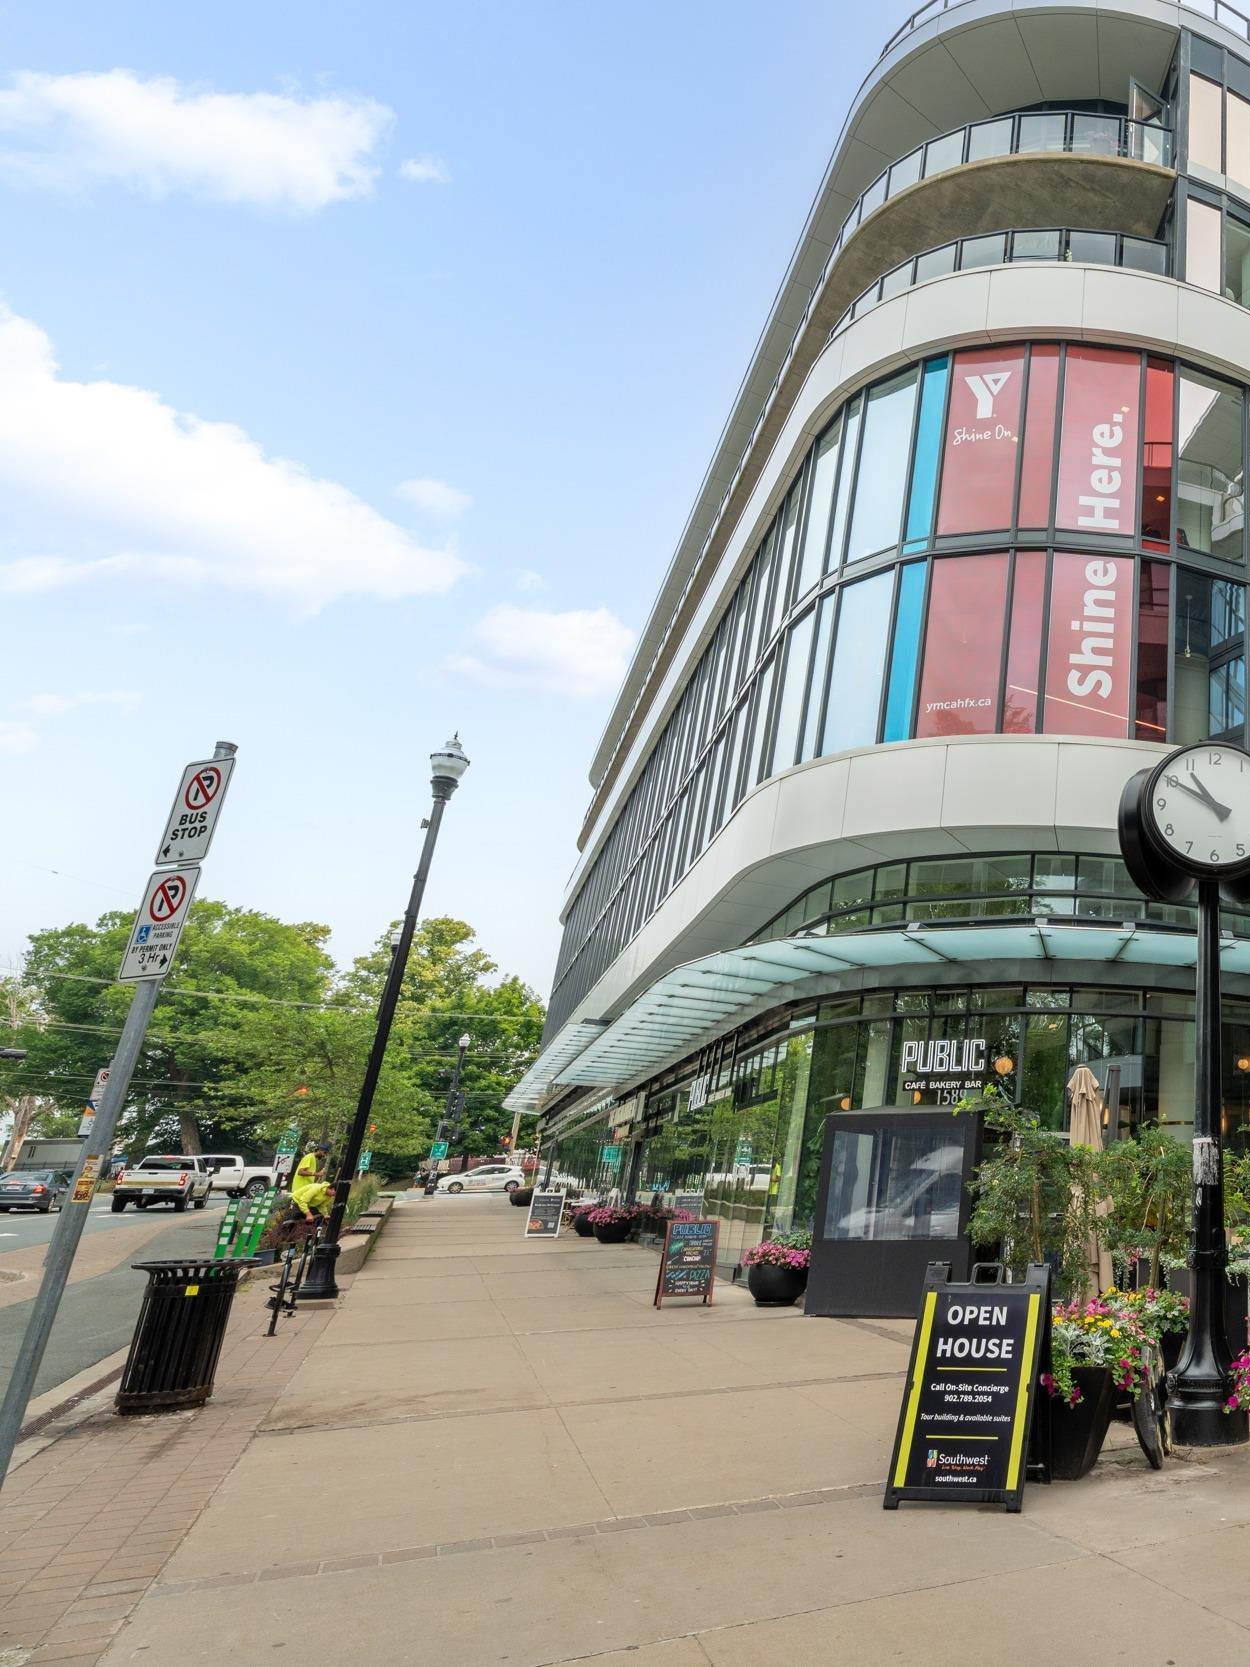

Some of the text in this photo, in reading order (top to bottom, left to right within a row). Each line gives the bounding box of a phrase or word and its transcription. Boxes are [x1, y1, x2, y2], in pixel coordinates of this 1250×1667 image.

[953, 427, 991, 445] Shine
[1067, 413, 1123, 699] Shine Here.
[925, 698, 992, 713] ymcahfx.ca
[1186, 759, 1195, 771] 11
[1209, 752, 1222, 765] 12
[1240, 760, 1244, 772] 1
[1166, 775, 1179, 788] 10
[1157, 798, 1167, 811] 9
[178, 811, 208, 826] BUS
[170, 825, 208, 841] STOP
[1164, 823, 1174, 837] 8
[1185, 841, 1194, 854] 7
[1236, 843, 1246, 857] 5
[1209, 849, 1220, 863] 6
[152, 921, 181, 931] ACCESSIBLE
[152, 931, 174, 939] PARKING
[131, 942, 173, 954] BY PERMIT ONLY
[138, 951, 161, 964] 3 Hr
[901, 1039, 986, 1073] PUBLIC
[904, 1080, 982, 1090] CAFÉ BAKERY BAR
[689, 1269, 710, 1280] PIZZA
[947, 1305, 1008, 1326] OPEN
[936, 1338, 1014, 1358] HOUSE
[931, 1383, 1009, 1393] Call On-Site Concierge
[944, 1394, 992, 1403] 902.789.2054
[935, 1414, 958, 1422] building
[964, 1414, 993, 1422] available
[938, 1453, 988, 1465] Southwest
[935, 1475, 977, 1483] southwest.ca
